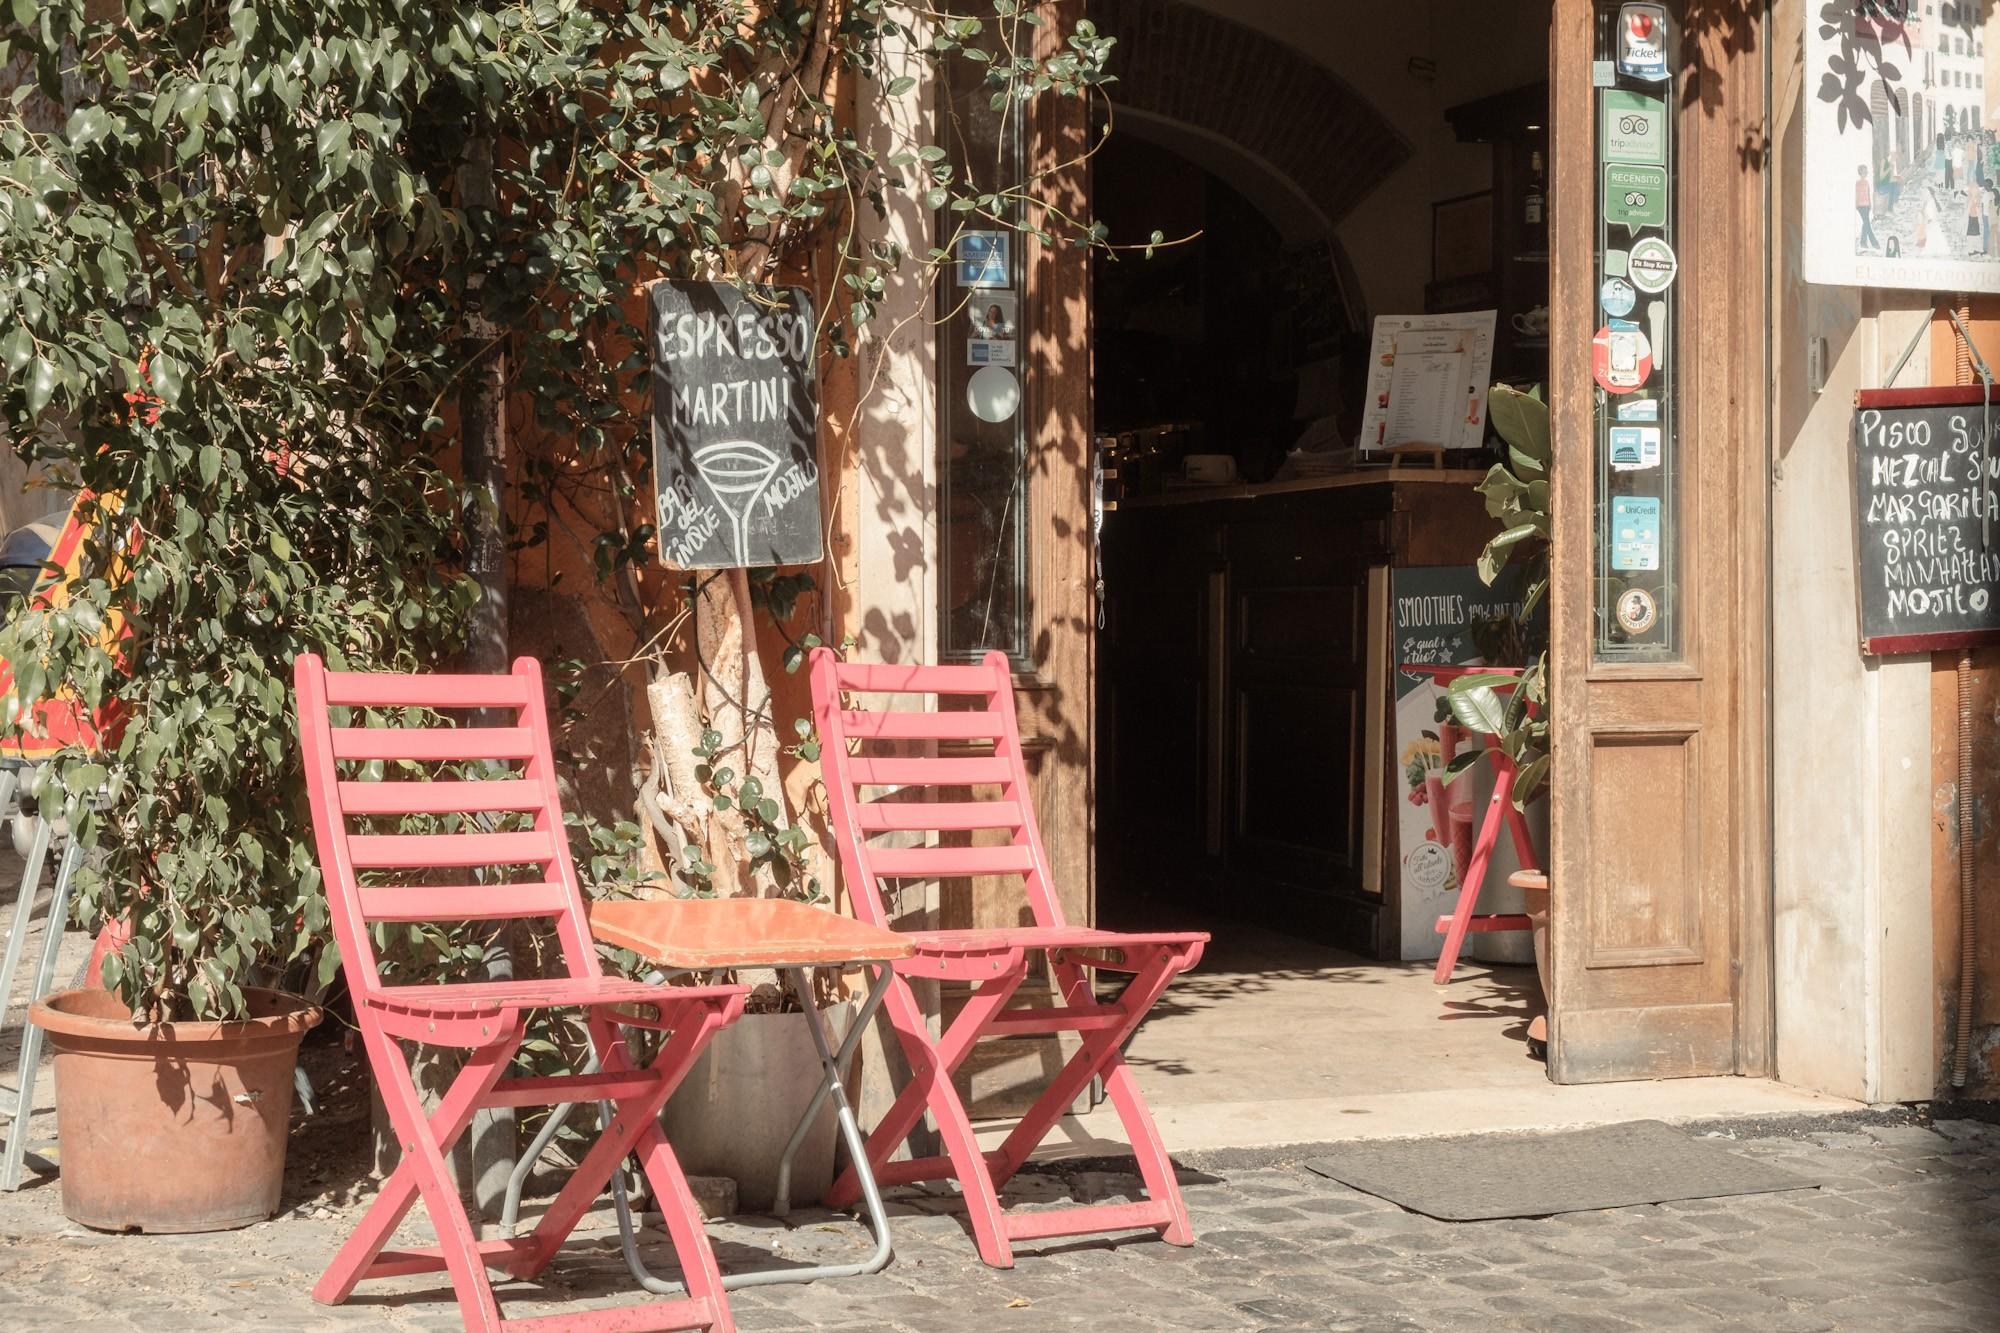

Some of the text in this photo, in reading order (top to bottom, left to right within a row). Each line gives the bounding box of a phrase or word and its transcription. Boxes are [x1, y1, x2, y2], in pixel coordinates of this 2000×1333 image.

[1625, 47, 1657, 58] Ticket
[1611, 172, 1661, 185] RECENSITO
[658, 308, 808, 362] ESPRESSO
[1872, 450, 1954, 488] MEZCAL
[657, 474, 693, 529] BAR
[1625, 505, 1656, 514] UniCredit
[1398, 595, 1464, 628] SMOOTHIES
[1416, 636, 1439, 654] qual
[1410, 649, 1437, 664] tuo?
